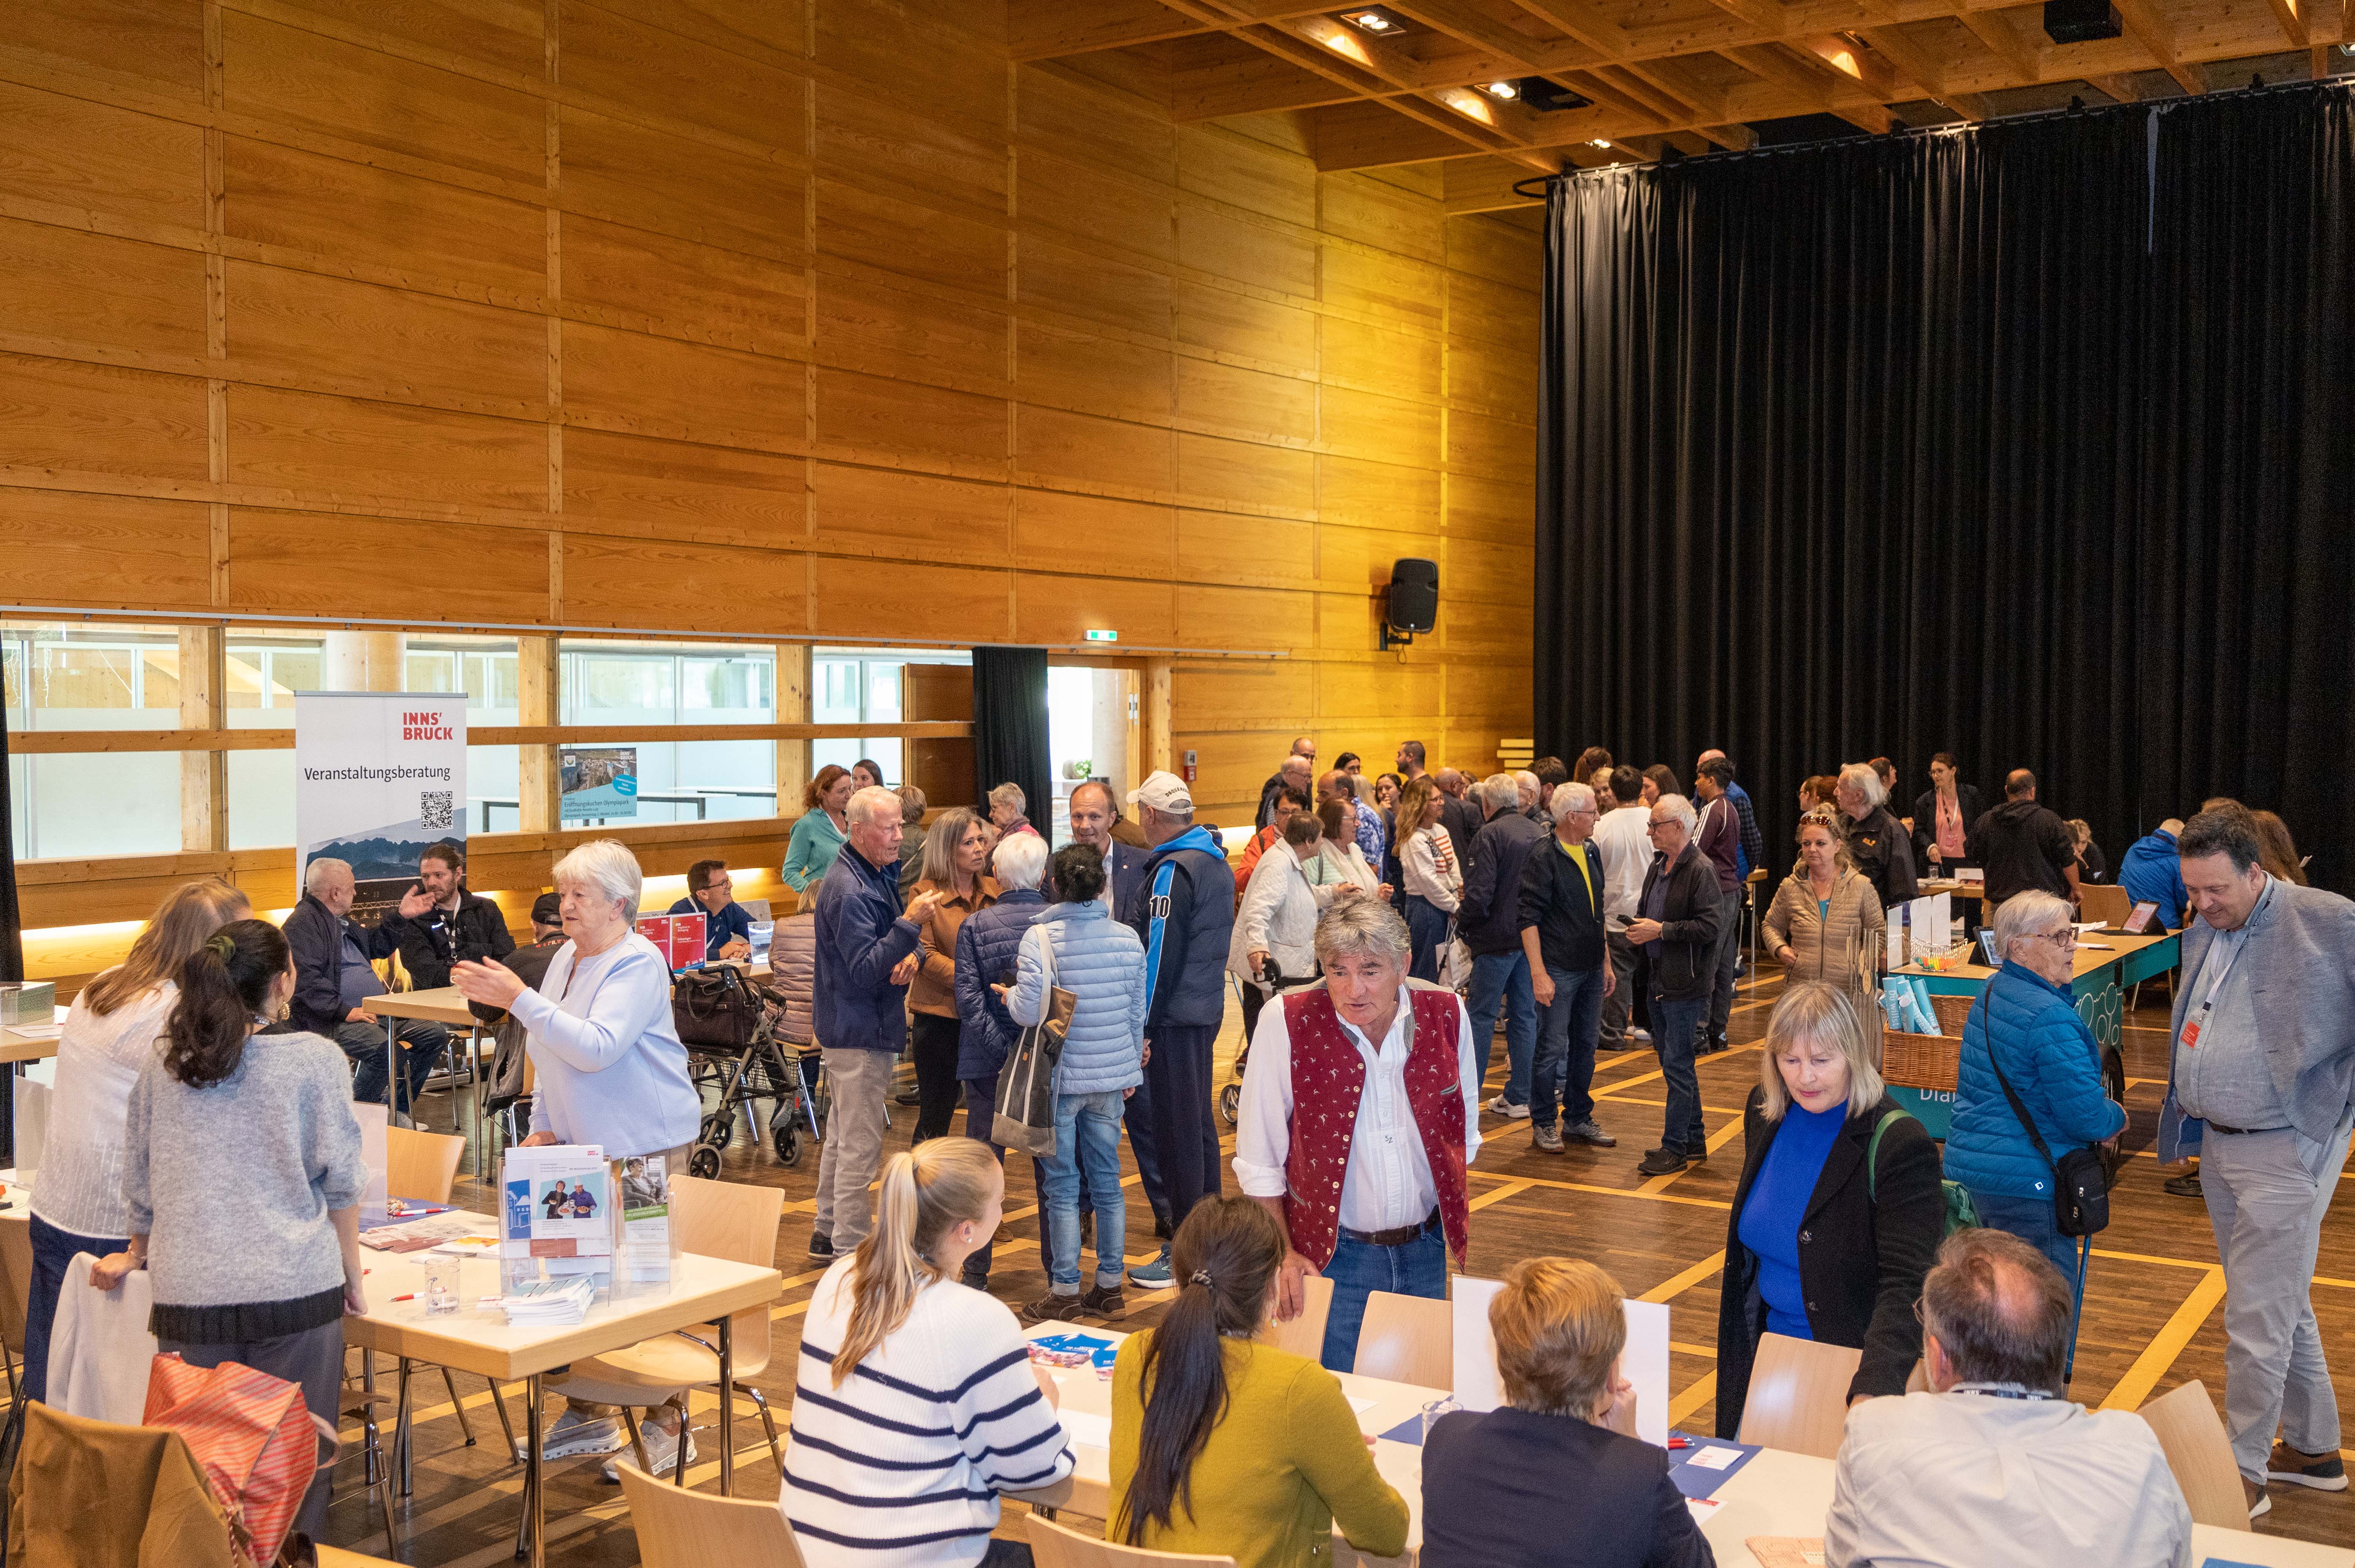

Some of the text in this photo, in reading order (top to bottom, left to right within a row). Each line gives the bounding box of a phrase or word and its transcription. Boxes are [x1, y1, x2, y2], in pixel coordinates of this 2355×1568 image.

[403, 712, 442, 725] INNS'
[403, 727, 453, 740] BRUCK
[304, 765, 451, 782] Veranstaltungsberatung
[1149, 895, 1171, 919] 10
[1888, 991, 1900, 1027] Du willst
